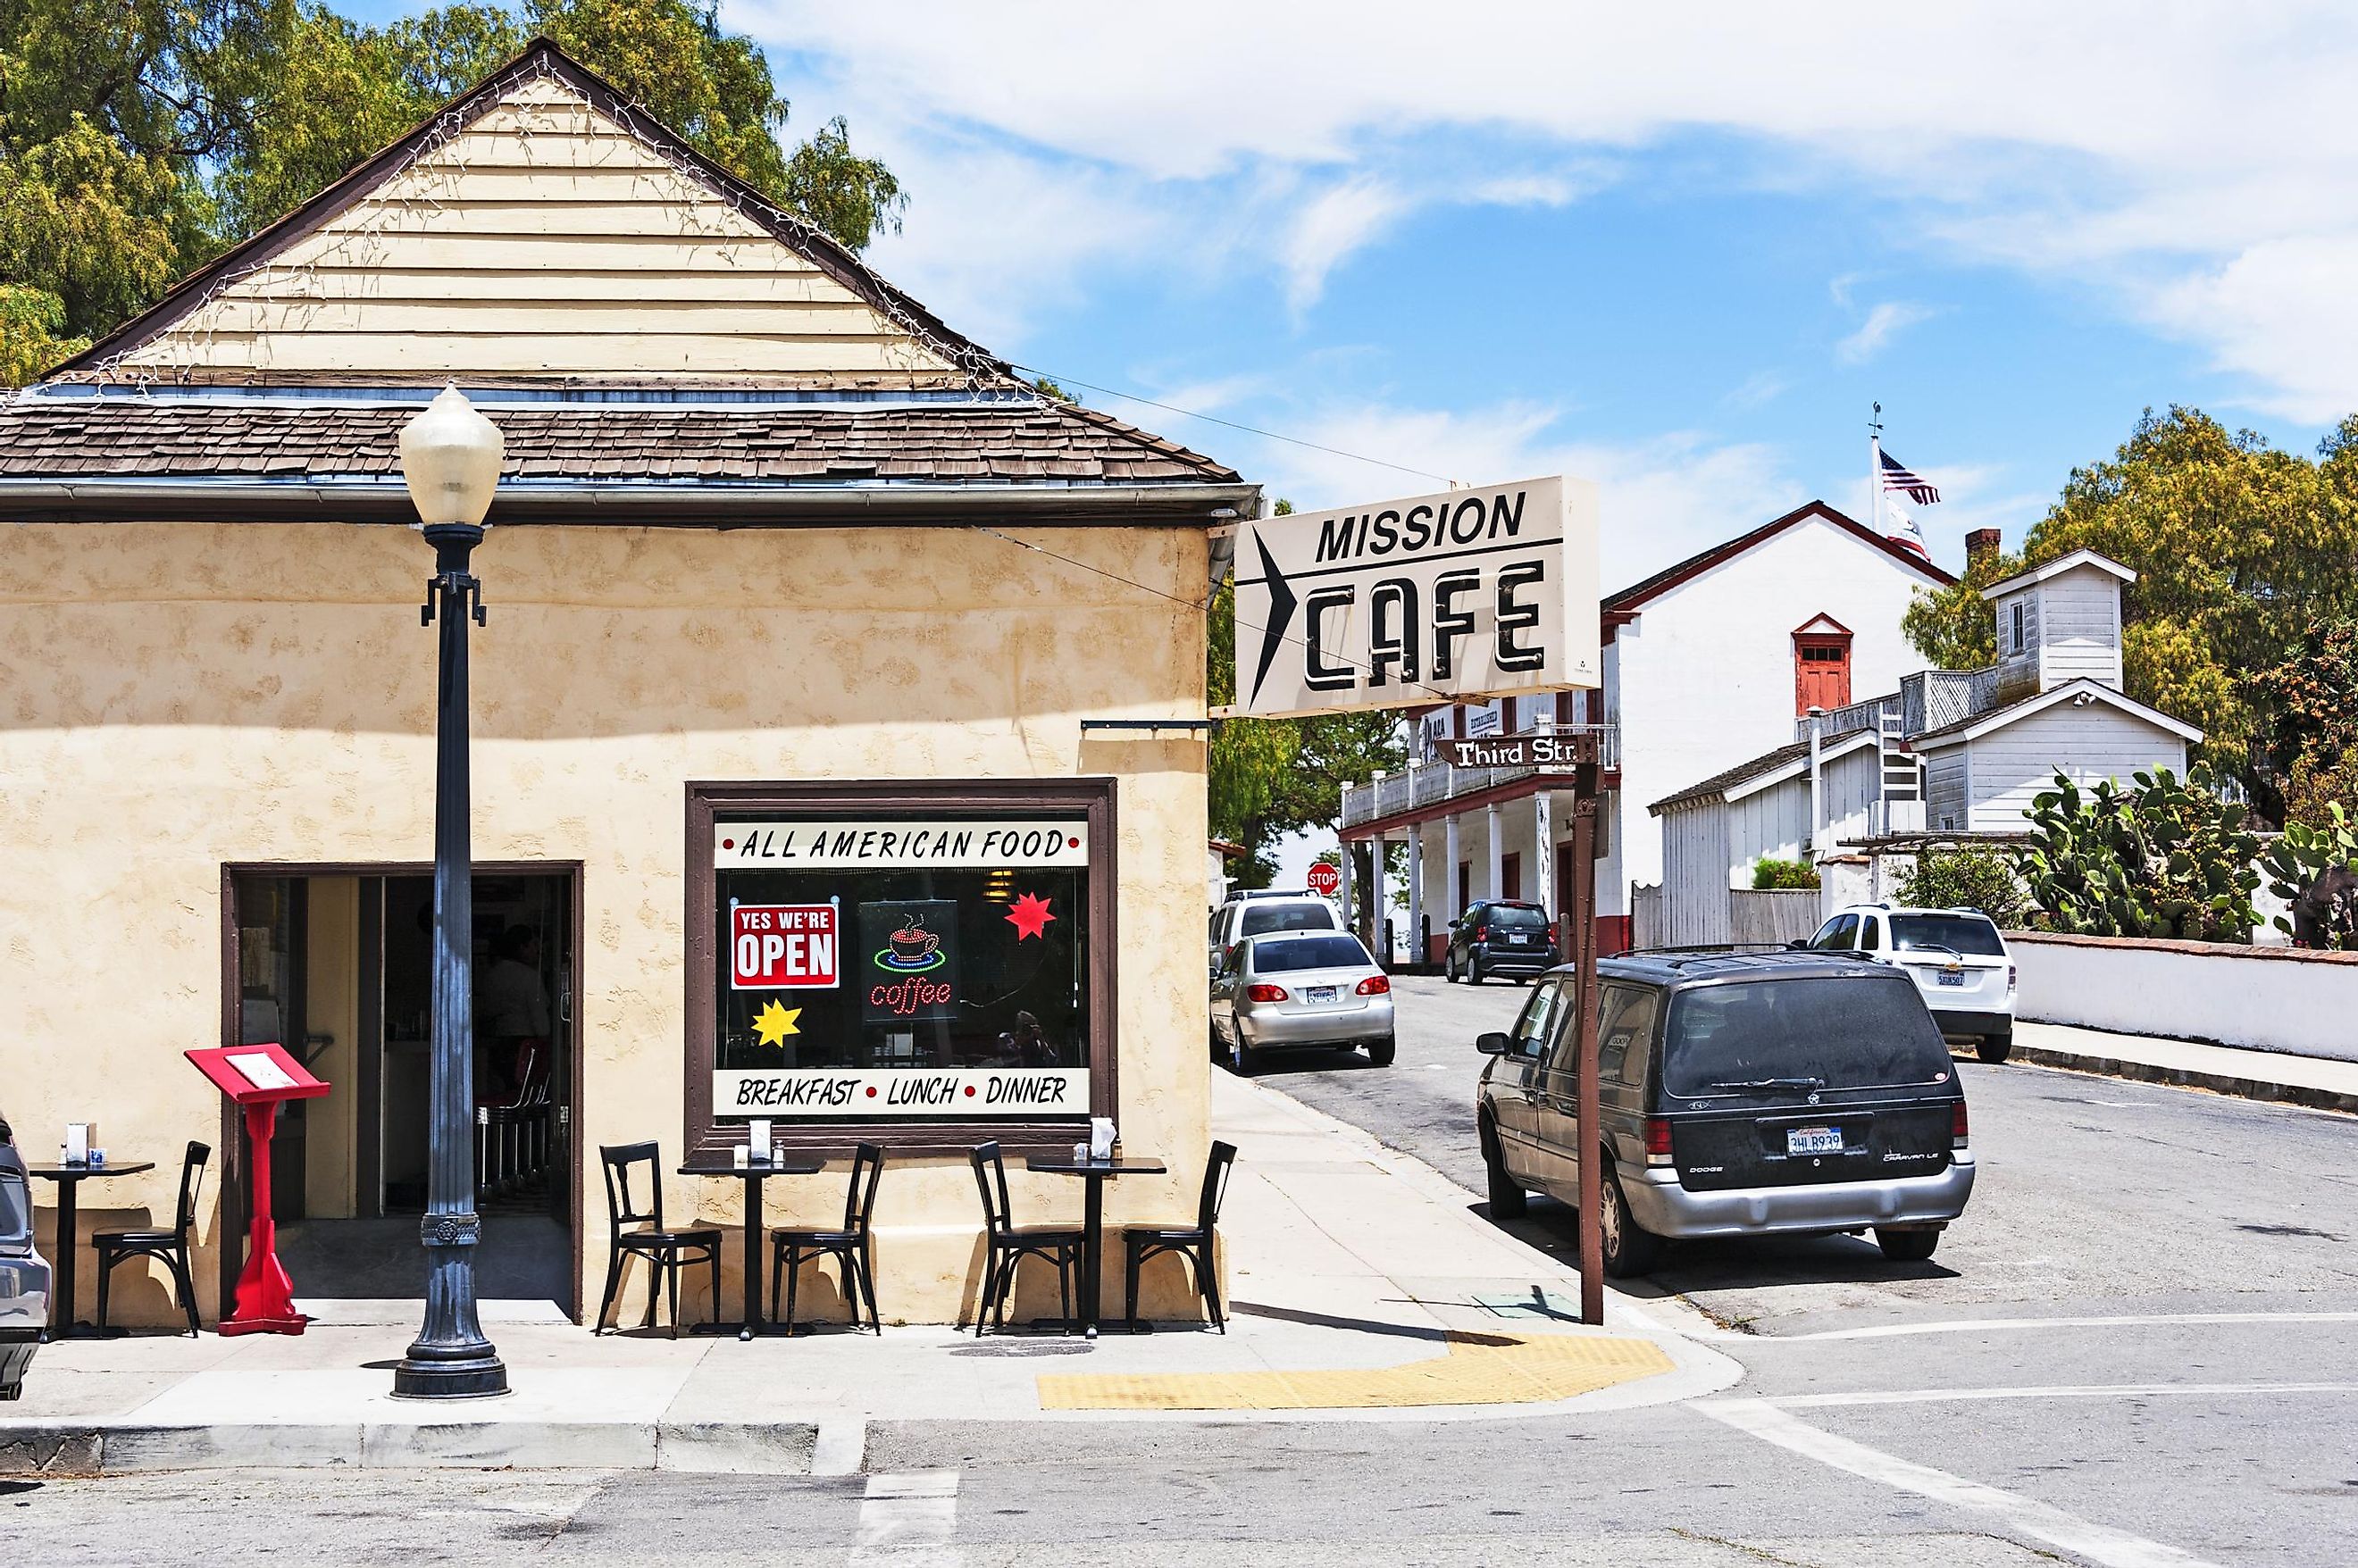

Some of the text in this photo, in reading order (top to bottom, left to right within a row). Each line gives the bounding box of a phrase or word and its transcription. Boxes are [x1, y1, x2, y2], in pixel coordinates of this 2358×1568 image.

[1316, 491, 1526, 563] MISSION
[1304, 560, 1545, 691] CAFE
[1455, 741, 1523, 768] Third
[1532, 737, 1577, 763] Str.
[740, 829, 1064, 859] ALL AMERICAN FOOD
[1309, 872, 1337, 886] STOP
[740, 911, 830, 930] YES WE'RE
[737, 933, 833, 978] OPEN
[870, 976, 952, 1014] coffee
[736, 1075, 1066, 1106] BREAKFAST LUNCH DINNER
[1791, 1135, 1840, 1152] 3HLB939
